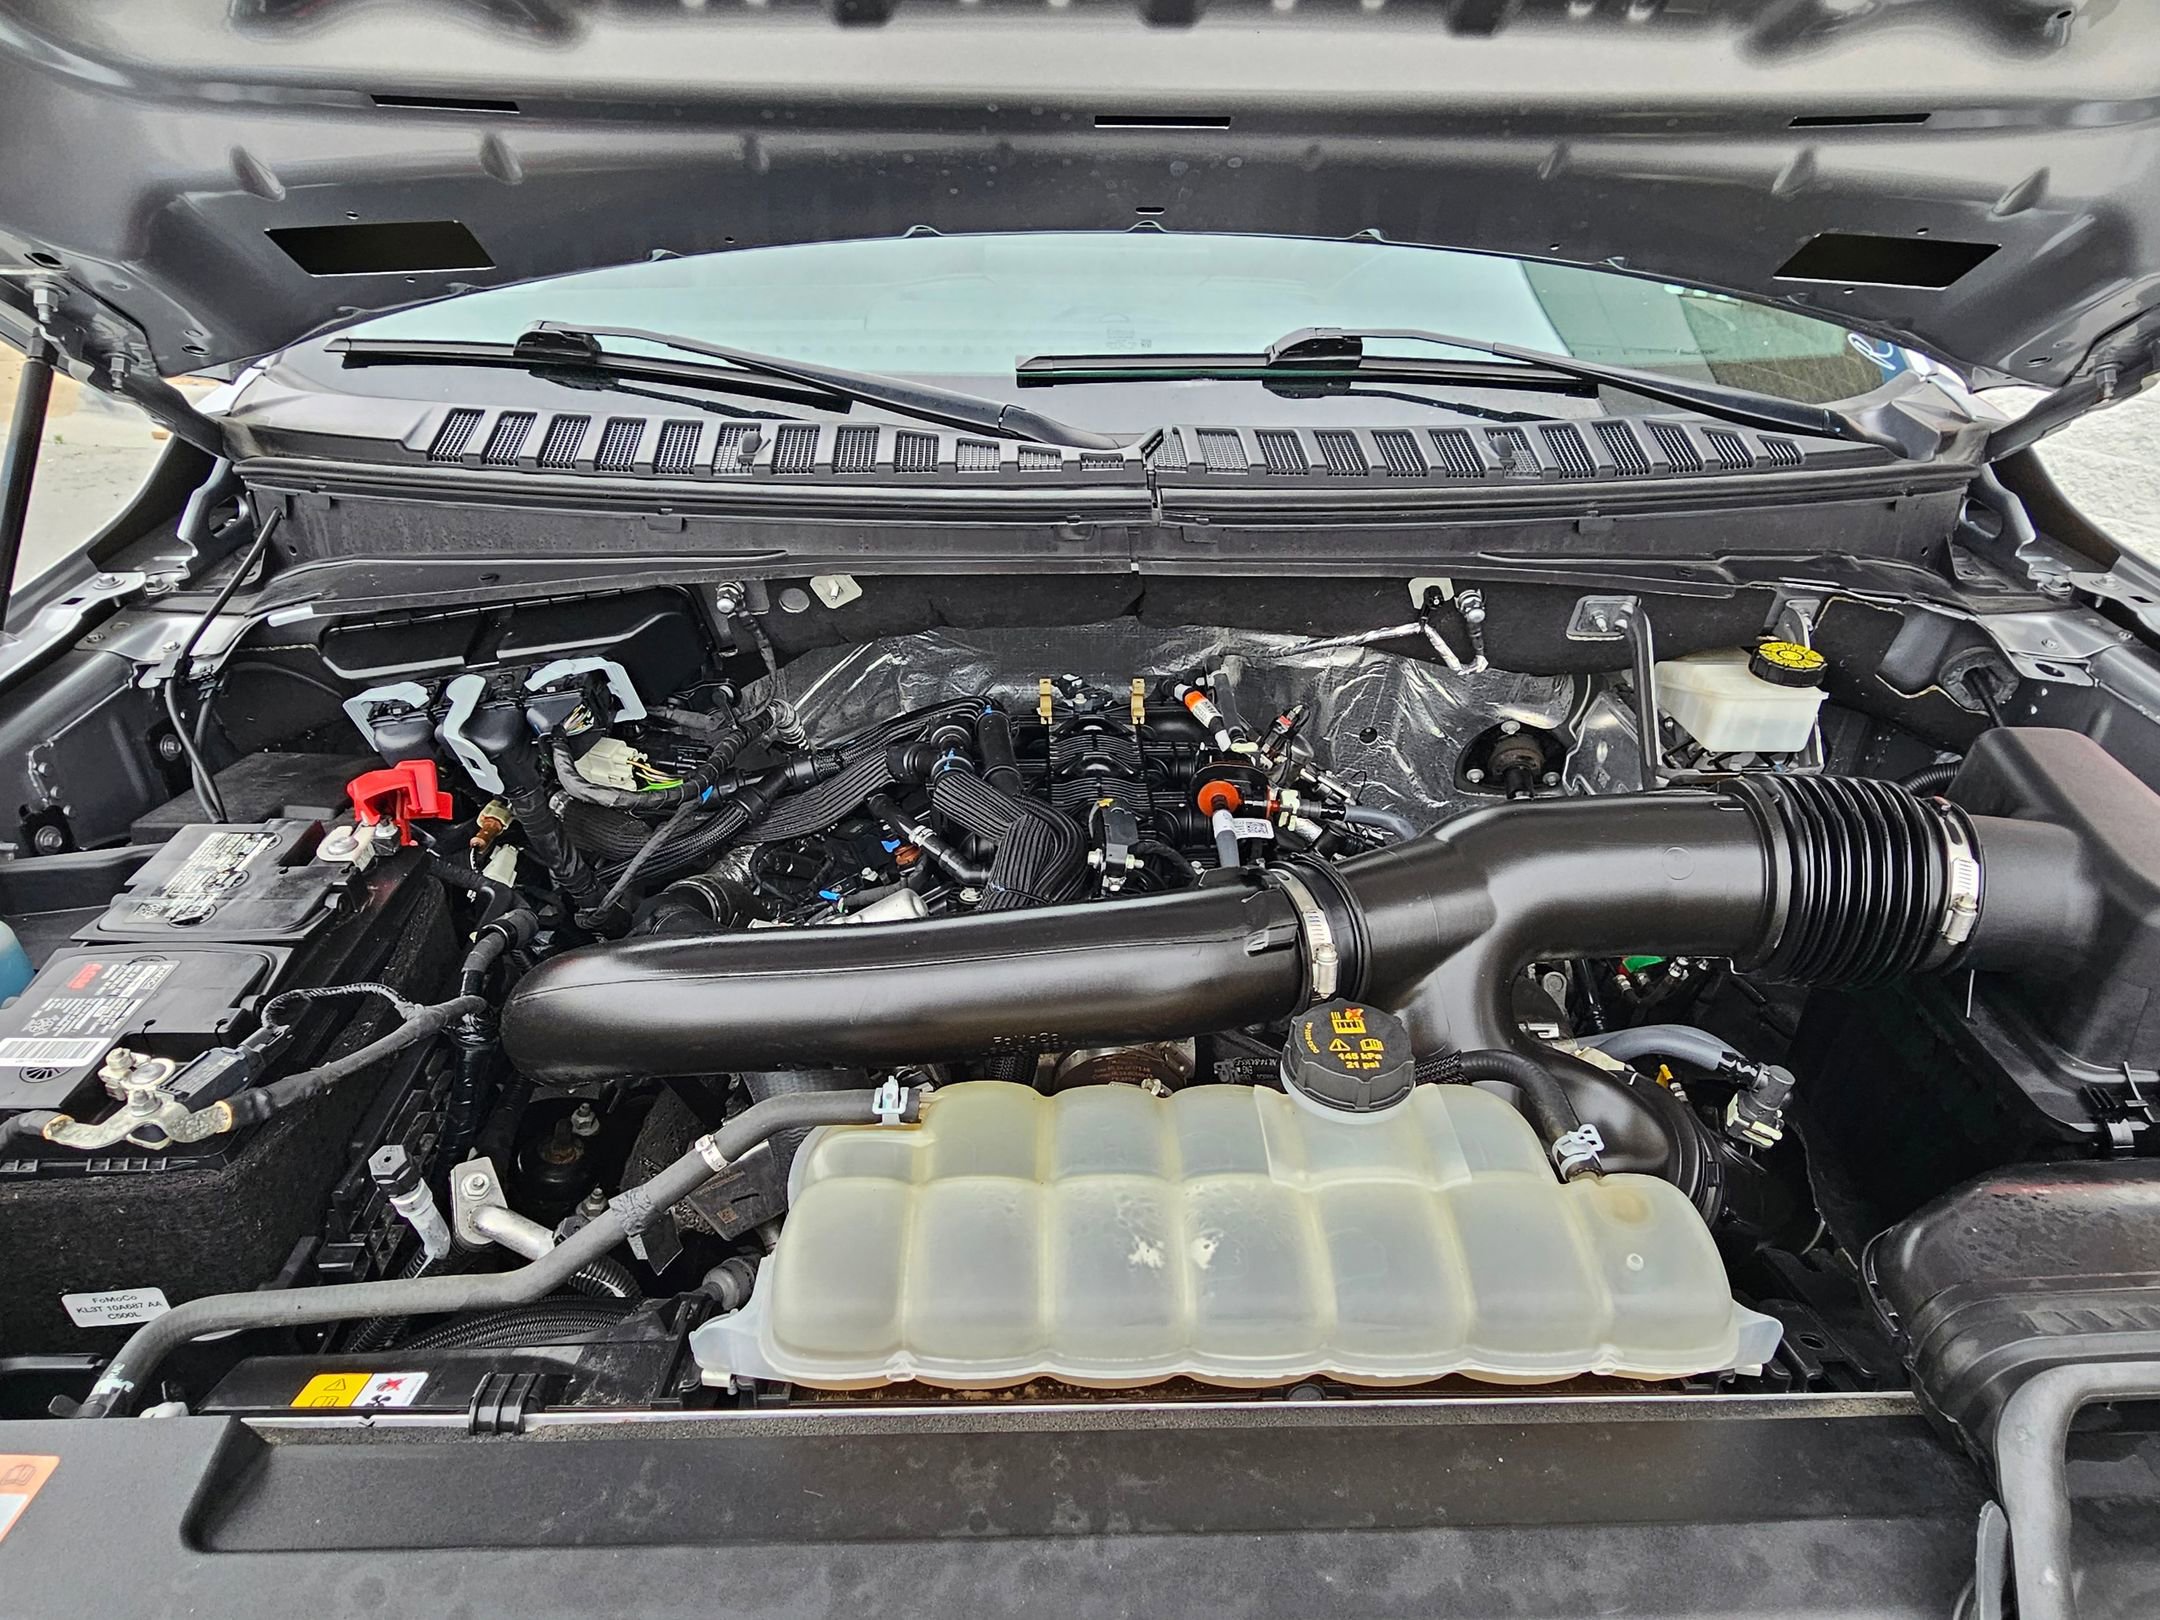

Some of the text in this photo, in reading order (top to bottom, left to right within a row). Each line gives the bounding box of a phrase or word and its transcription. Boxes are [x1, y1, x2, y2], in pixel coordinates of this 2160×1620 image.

[1338, 1052, 1383, 1060] 145 kPa
[1345, 1061, 1380, 1070] 21 psi
[92, 1295, 138, 1304] FoMoCo
[76, 1305, 103, 1314] KL3T
[147, 1300, 163, 1308] AA
